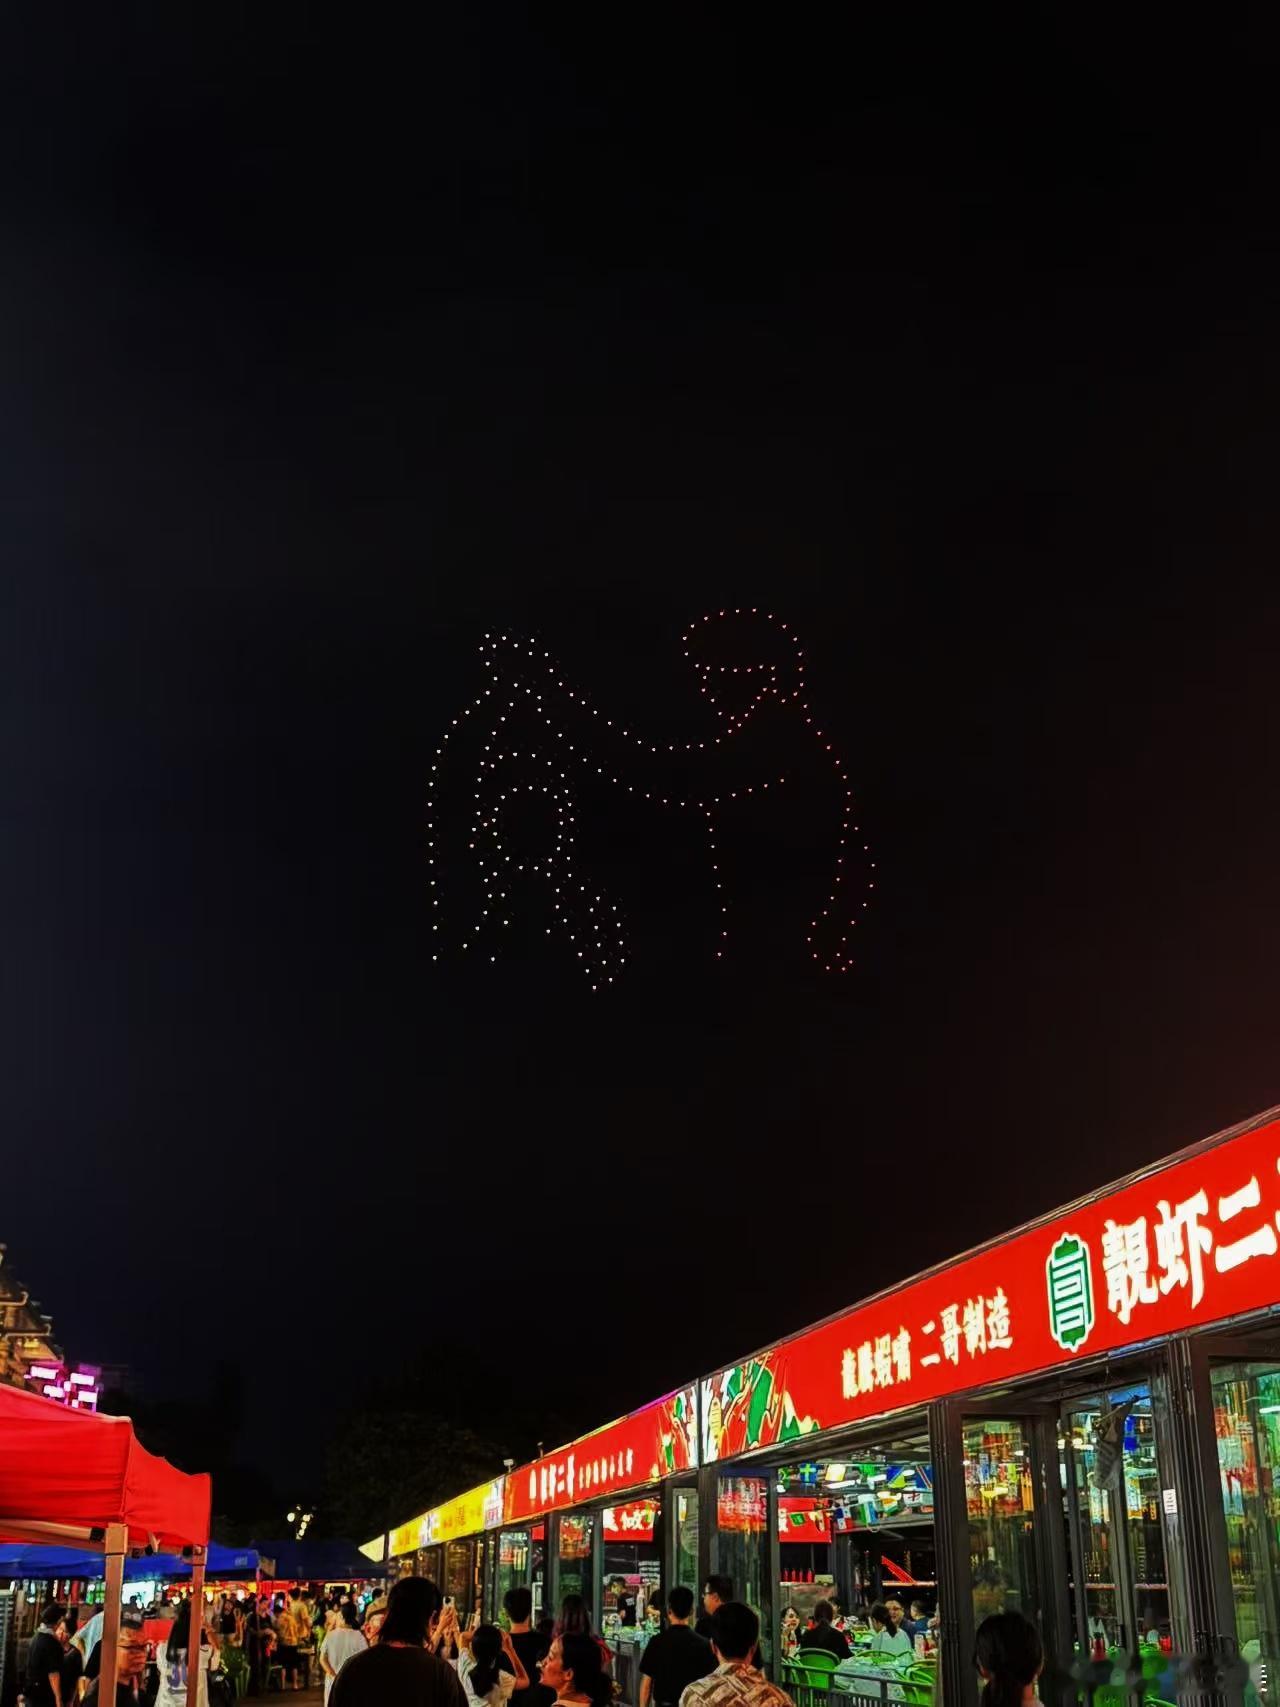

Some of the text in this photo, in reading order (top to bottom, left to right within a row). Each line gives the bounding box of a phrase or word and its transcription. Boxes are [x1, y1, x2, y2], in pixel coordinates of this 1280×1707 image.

[1101, 1156, 1280, 1325] 靚虾二
[920, 1286, 1013, 1367] 二哥制造
